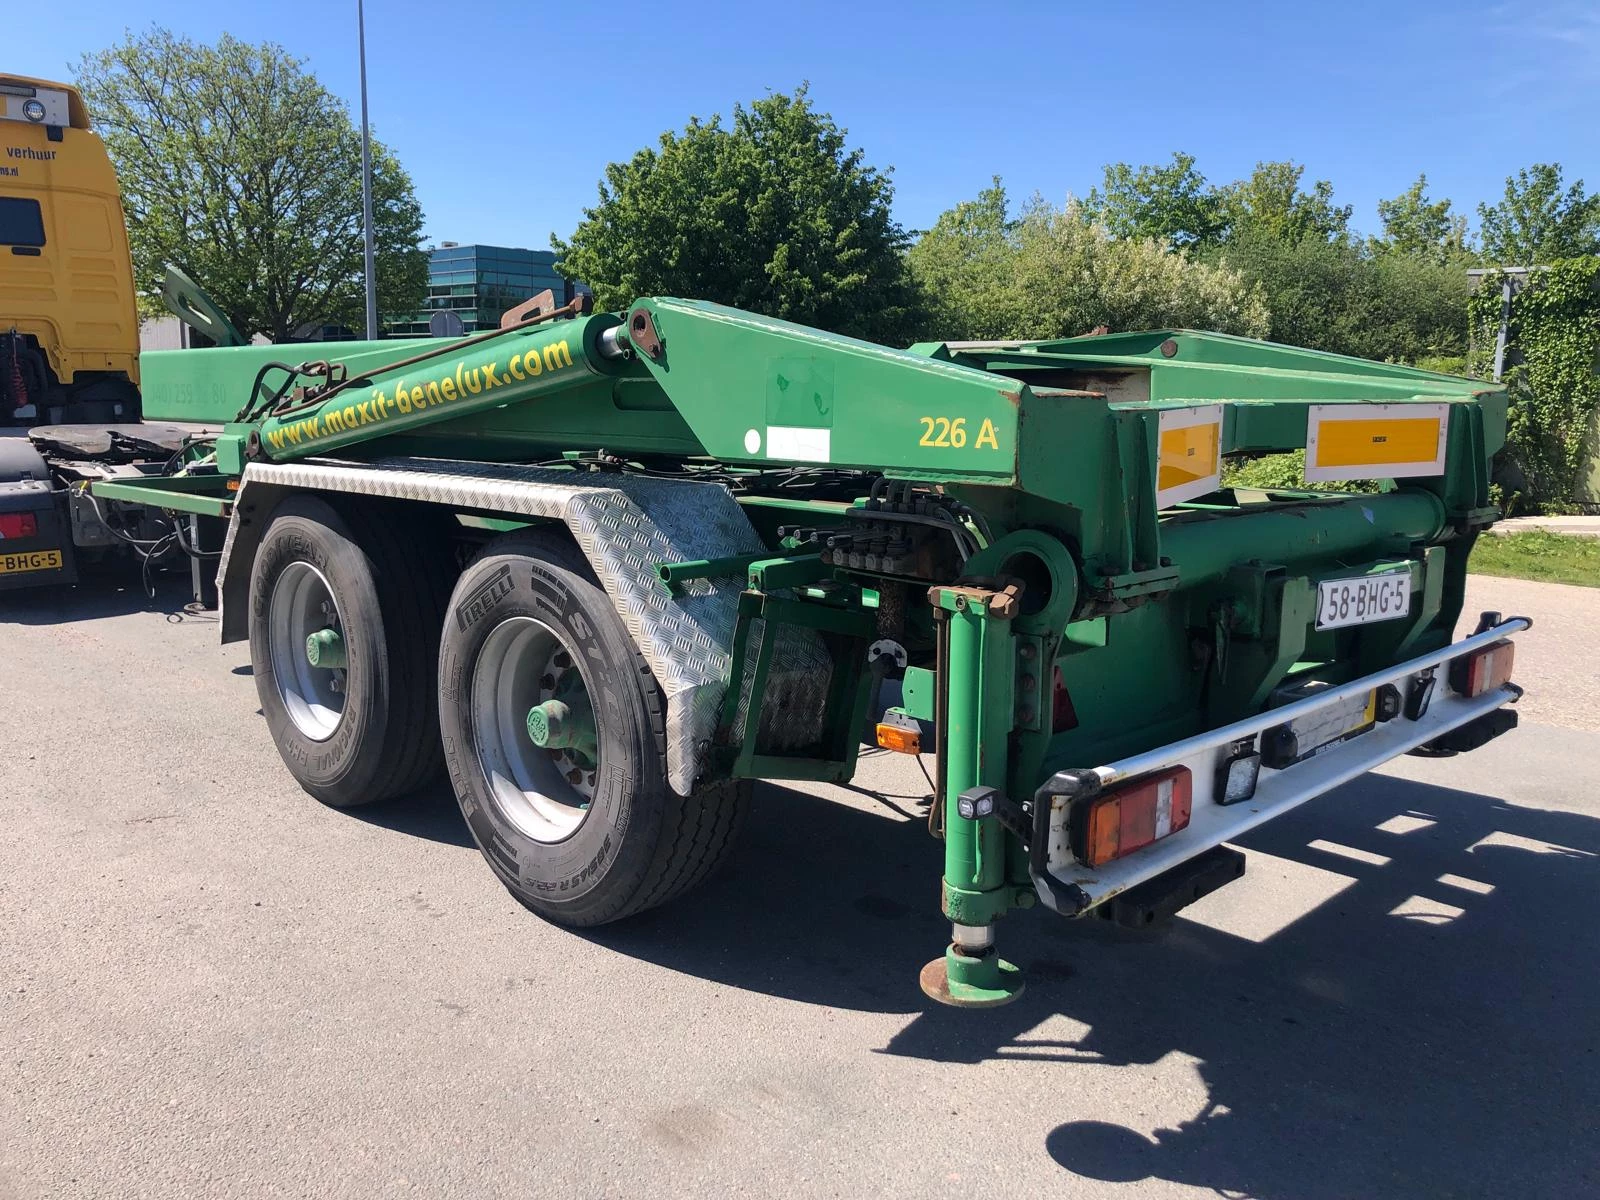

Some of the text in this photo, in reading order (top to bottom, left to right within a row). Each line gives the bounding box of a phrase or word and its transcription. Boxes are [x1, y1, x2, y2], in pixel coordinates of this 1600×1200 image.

[6, 146, 56, 160] verhuur
[268, 339, 573, 449] www.maxit-benelux.com
[920, 416, 998, 450] 226 A
[455, 563, 516, 634] PIRELLI
[1328, 580, 1405, 621] 58-BHG-5
